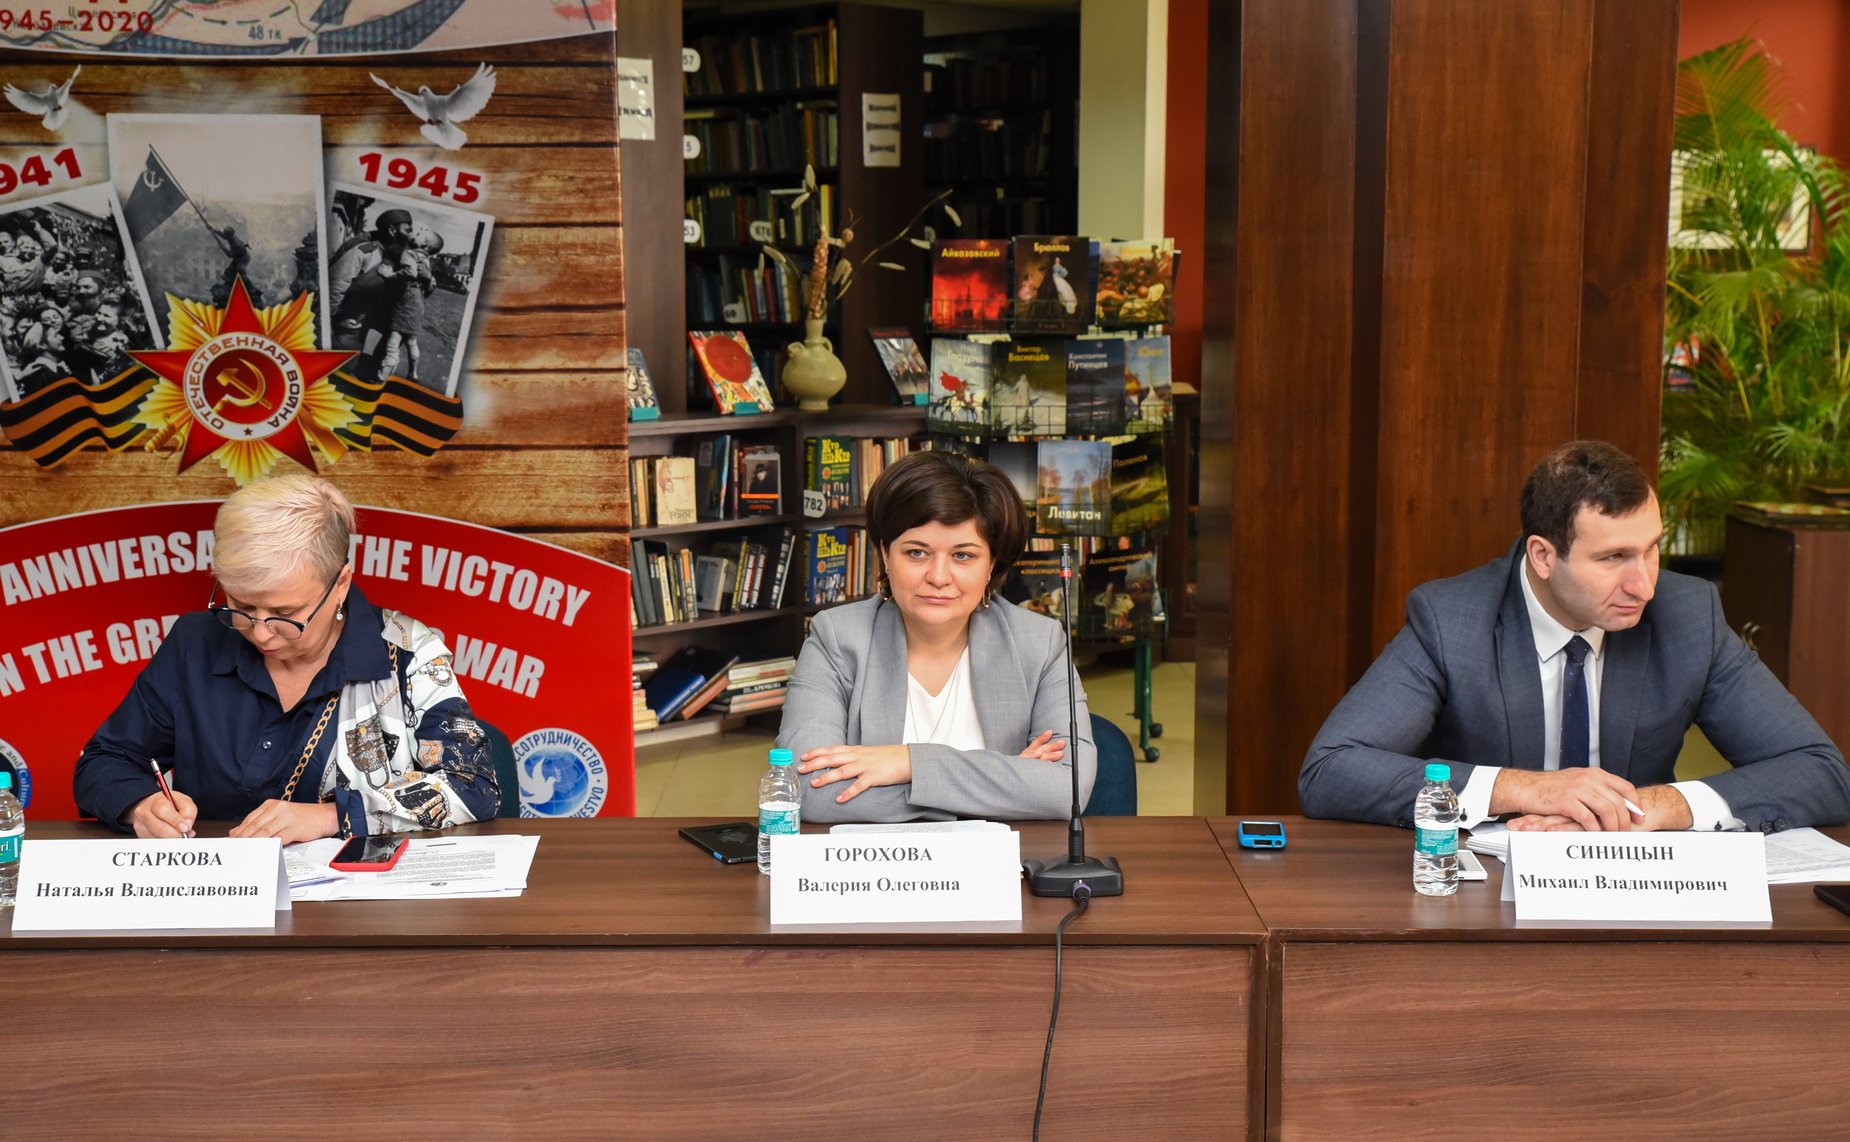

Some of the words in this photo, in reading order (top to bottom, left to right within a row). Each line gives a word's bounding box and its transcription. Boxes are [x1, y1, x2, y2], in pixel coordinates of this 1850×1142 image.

[358, 152, 482, 204] 1945
[189, 336, 290, 430] ОТЕЧЕСТВЕННАЯ
[804, 497, 822, 511] 782
[0, 530, 216, 606] ANNIVERSA
[421, 544, 591, 627] VICTORY
[22, 629, 103, 685] THE
[453, 634, 545, 699] WAR
[514, 731, 604, 775] СОТРУДНИЧЕСТВО
[112, 852, 223, 866] СТАРКОВА
[824, 847, 933, 862] ГОРОХОВА
[1566, 845, 1674, 862] СИНИЦЫН
[36, 882, 114, 897] Наталья
[121, 882, 259, 898] Владиславовна
[798, 878, 871, 895] Валерия
[876, 877, 960, 892] Олеговна
[1519, 874, 1589, 889] Михаил
[1595, 874, 1728, 894] Владимирович
